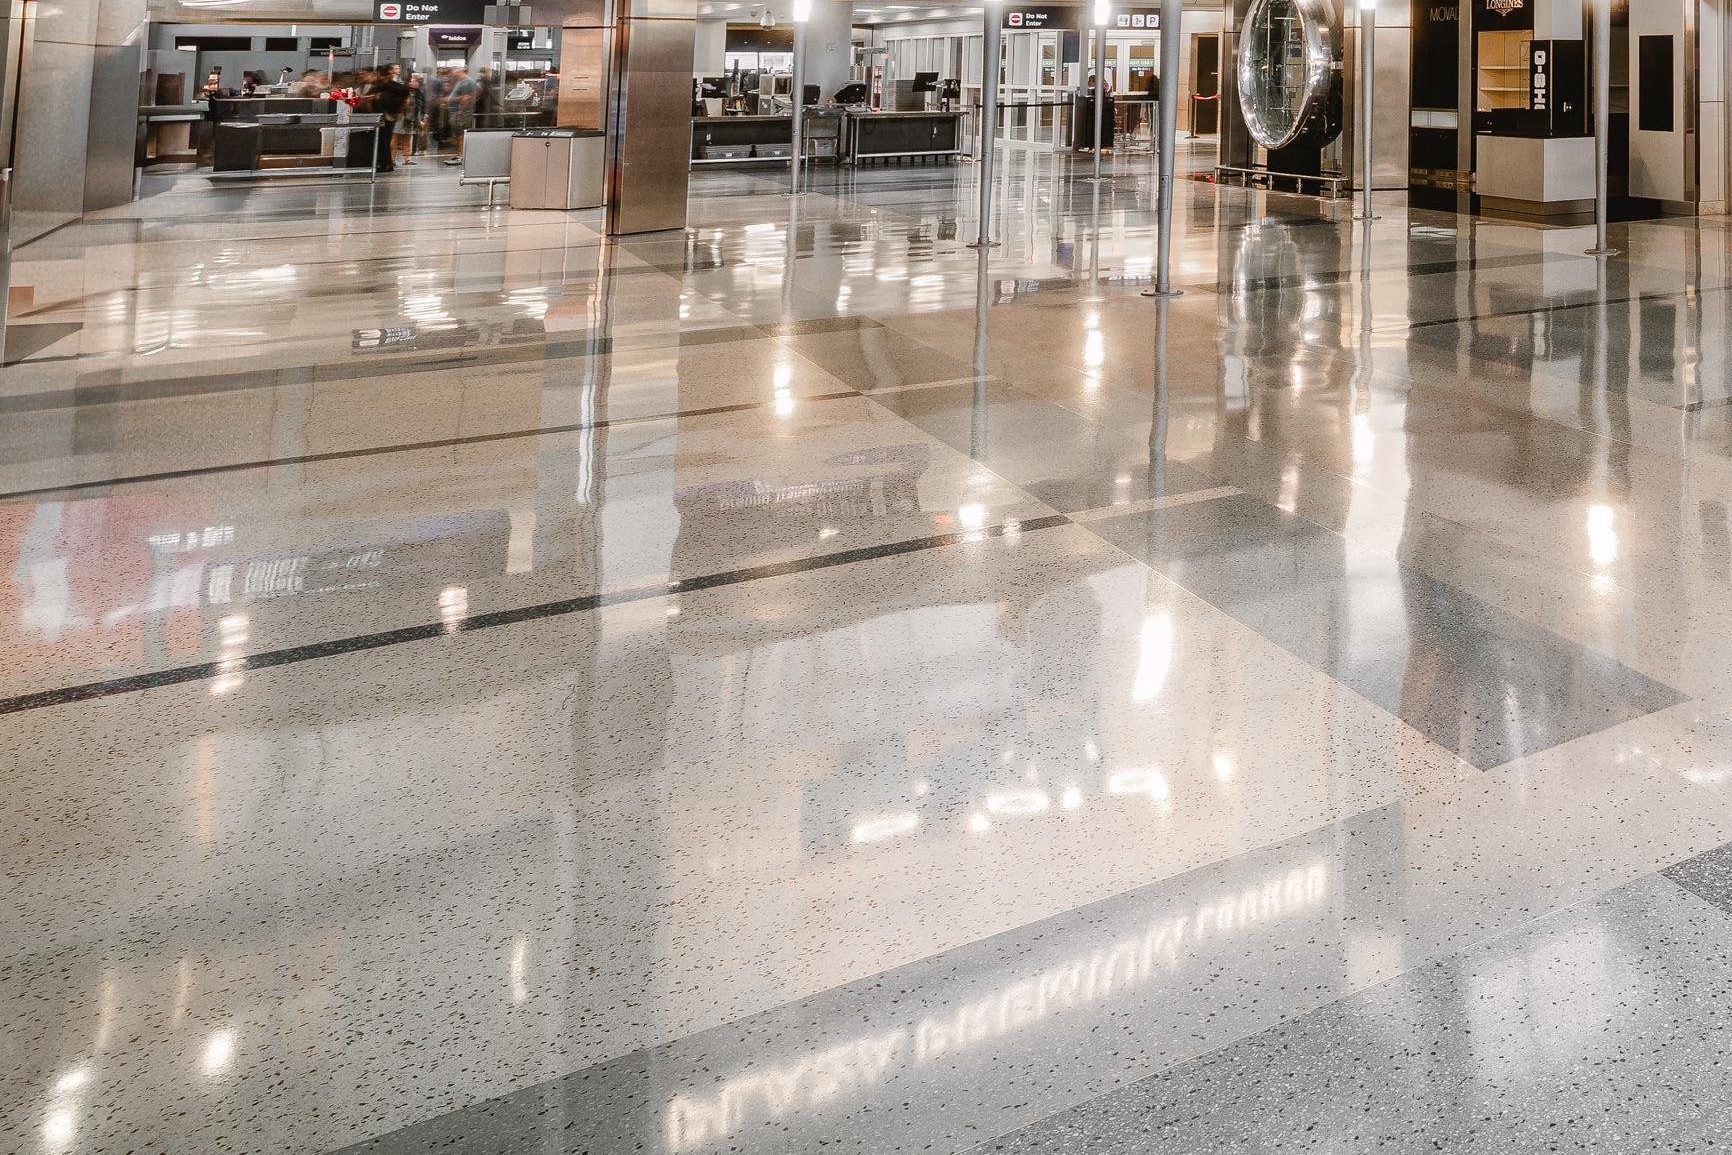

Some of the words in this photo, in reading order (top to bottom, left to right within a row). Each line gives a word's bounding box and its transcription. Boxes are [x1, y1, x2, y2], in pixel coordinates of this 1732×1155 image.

[406, 4, 420, 12] Do
[421, 4, 438, 12] Not
[405, 13, 430, 21] Enter
